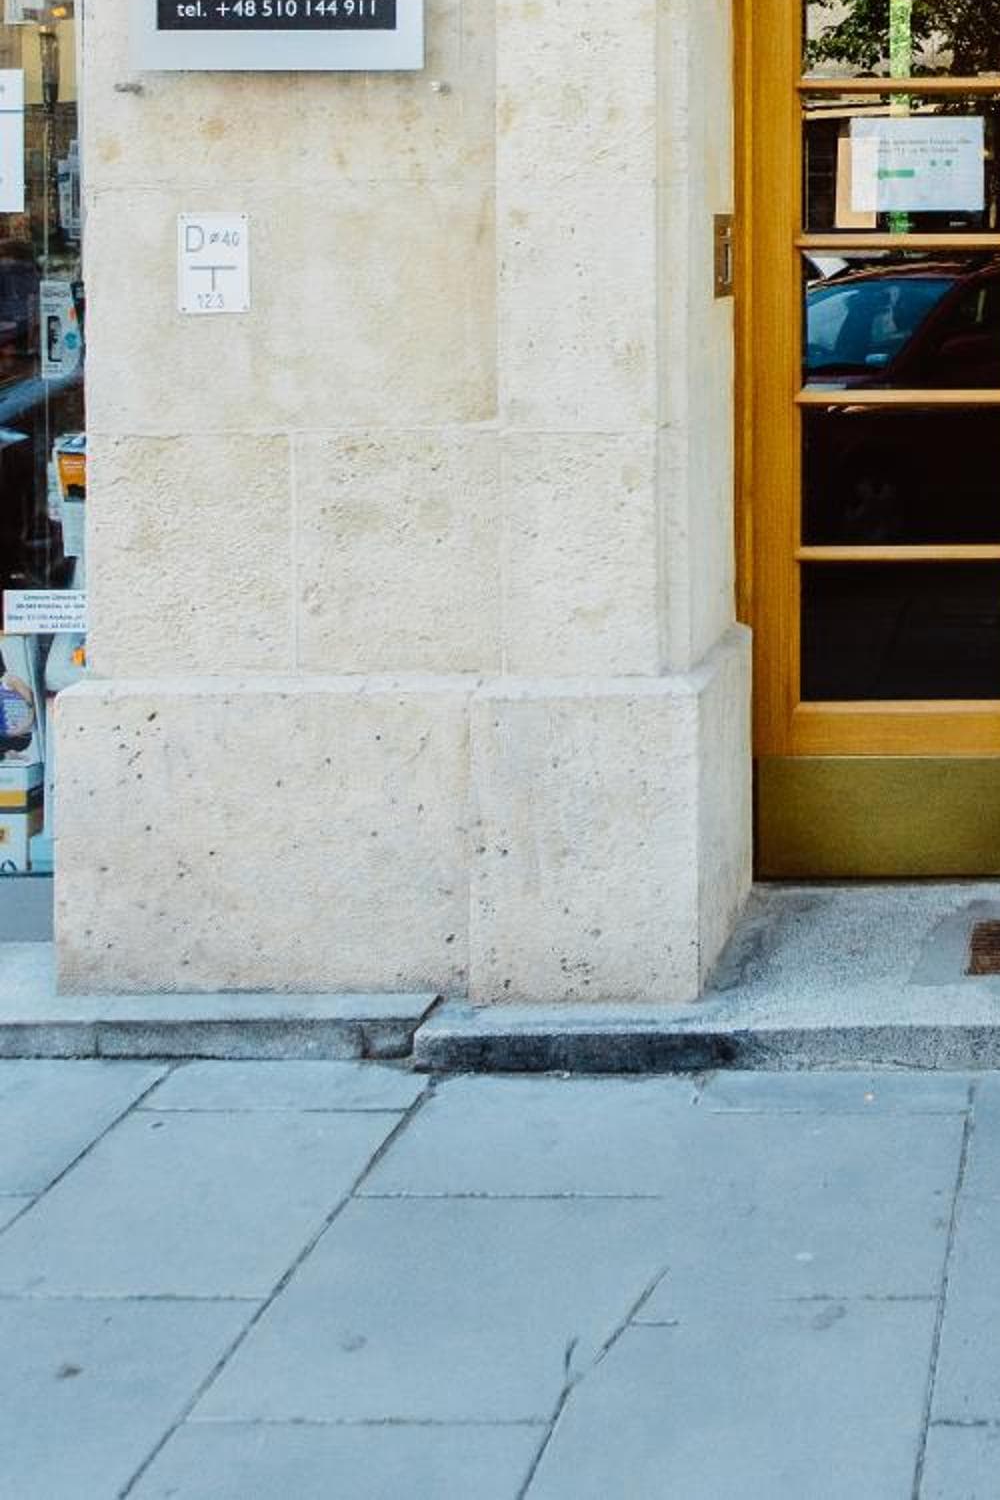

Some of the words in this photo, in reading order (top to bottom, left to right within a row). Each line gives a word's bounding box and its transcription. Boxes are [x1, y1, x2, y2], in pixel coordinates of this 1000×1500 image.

[176, 1, 207, 17] tel.
[215, 0, 256, 17] +48
[262, 0, 297, 17] 510
[306, 0, 338, 17] 144
[344, 0, 376, 17] 911
[186, 225, 205, 253] D
